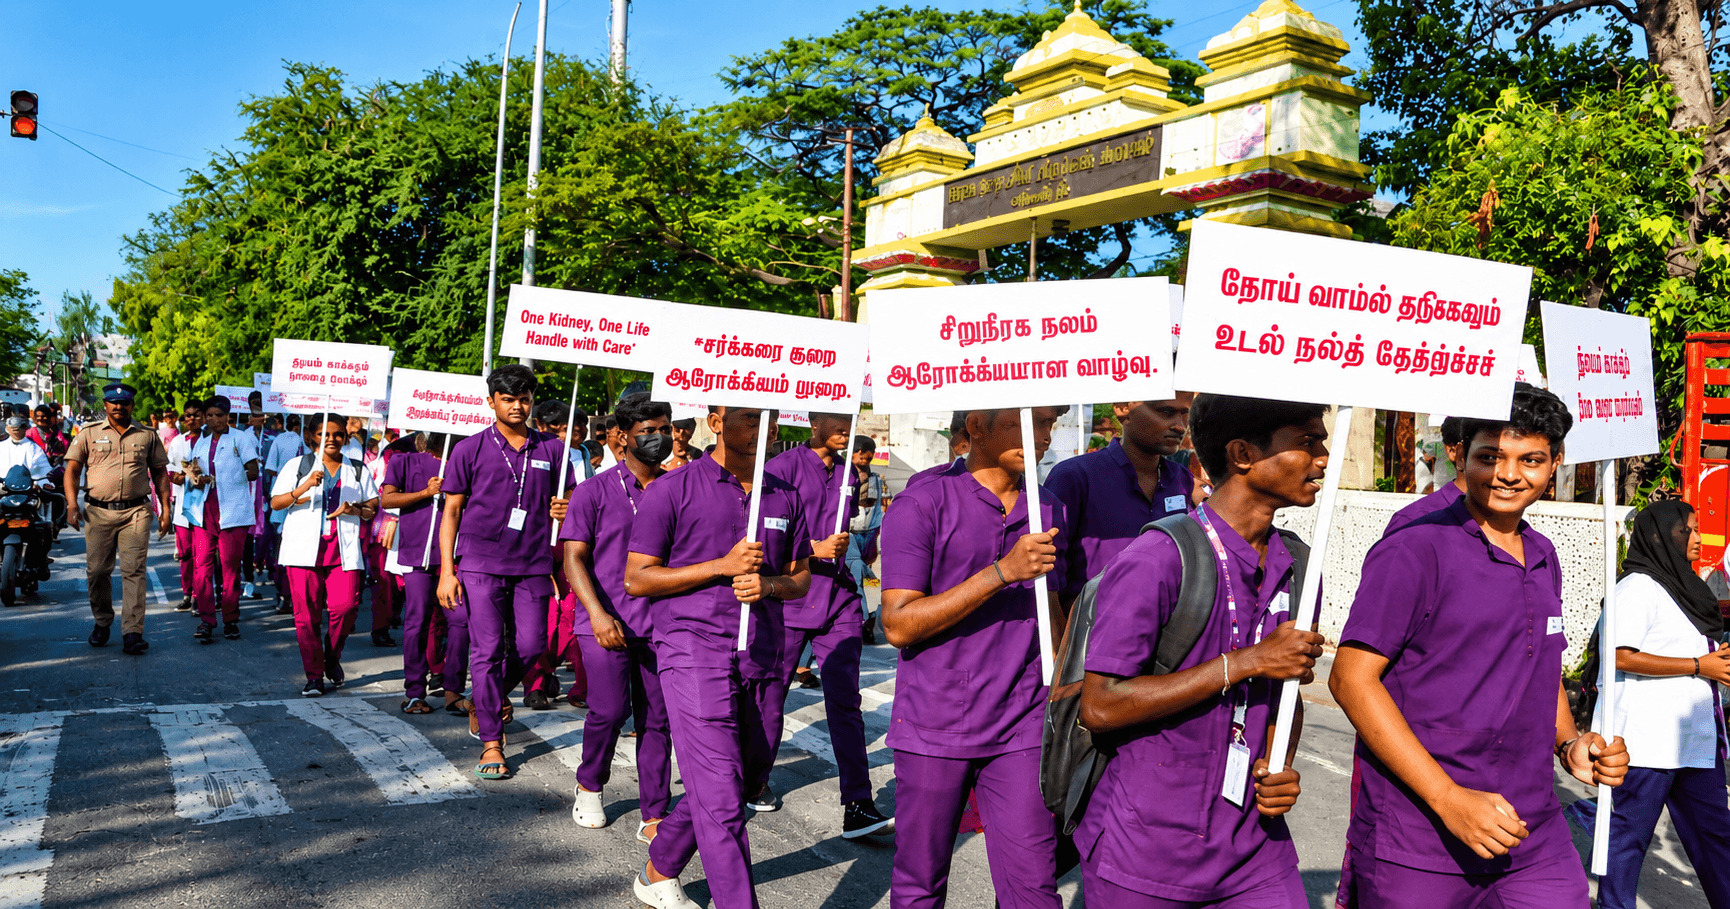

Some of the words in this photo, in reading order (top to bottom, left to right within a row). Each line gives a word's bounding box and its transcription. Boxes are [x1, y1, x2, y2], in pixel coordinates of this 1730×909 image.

[520, 309, 545, 326] One
[548, 311, 594, 333] Kidney,
[598, 317, 623, 334] One
[626, 320, 650, 337] Life
[1041, 308, 1098, 341] நலம்
[525, 329, 569, 348] Handle
[572, 336, 599, 352] with
[1214, 323, 1285, 355] உடல்
